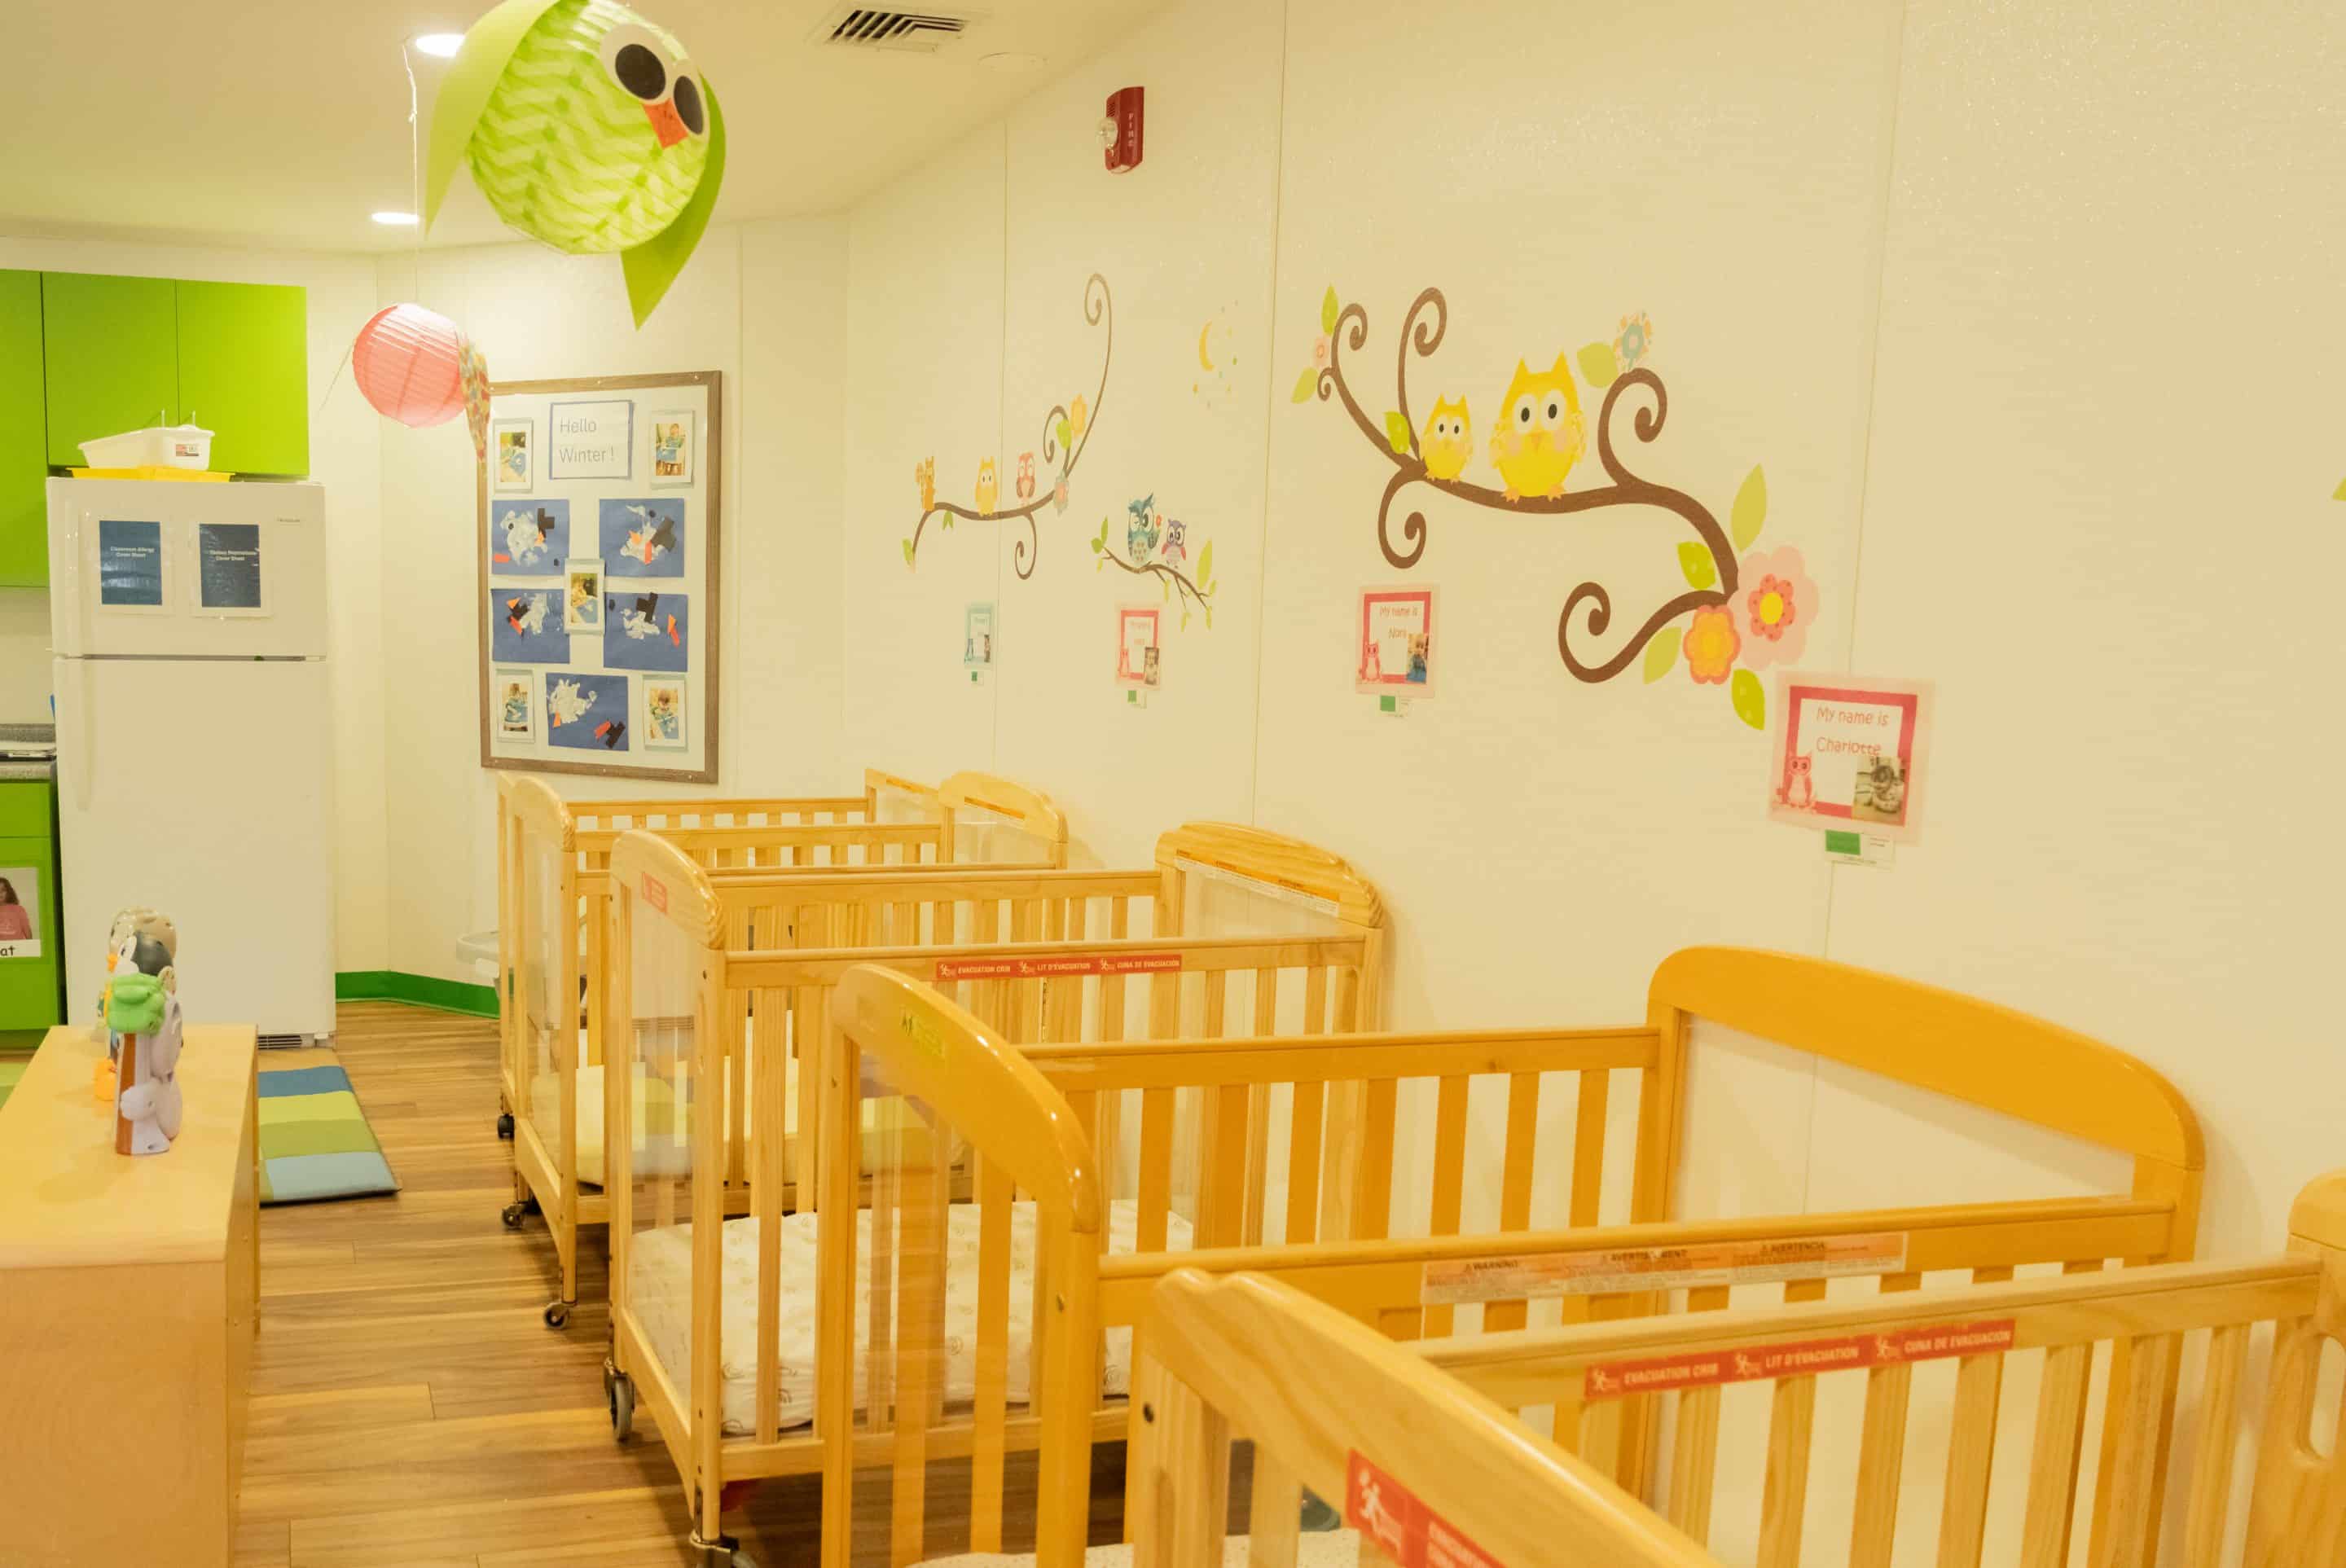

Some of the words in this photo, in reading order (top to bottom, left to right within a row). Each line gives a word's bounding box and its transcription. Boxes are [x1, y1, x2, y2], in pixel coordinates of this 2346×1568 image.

[560, 416, 597, 433] Hello
[1817, 706, 1836, 723] My
[1838, 710, 1874, 724] name
[1877, 710, 1889, 727] is
[1816, 736, 1882, 757] Charlotte
[1904, 1339, 1931, 1353] CUNA
[1935, 1337, 1948, 1351] DE
[1765, 1354, 1782, 1368] LIT
[1624, 1366, 1690, 1385] EVACUATION
